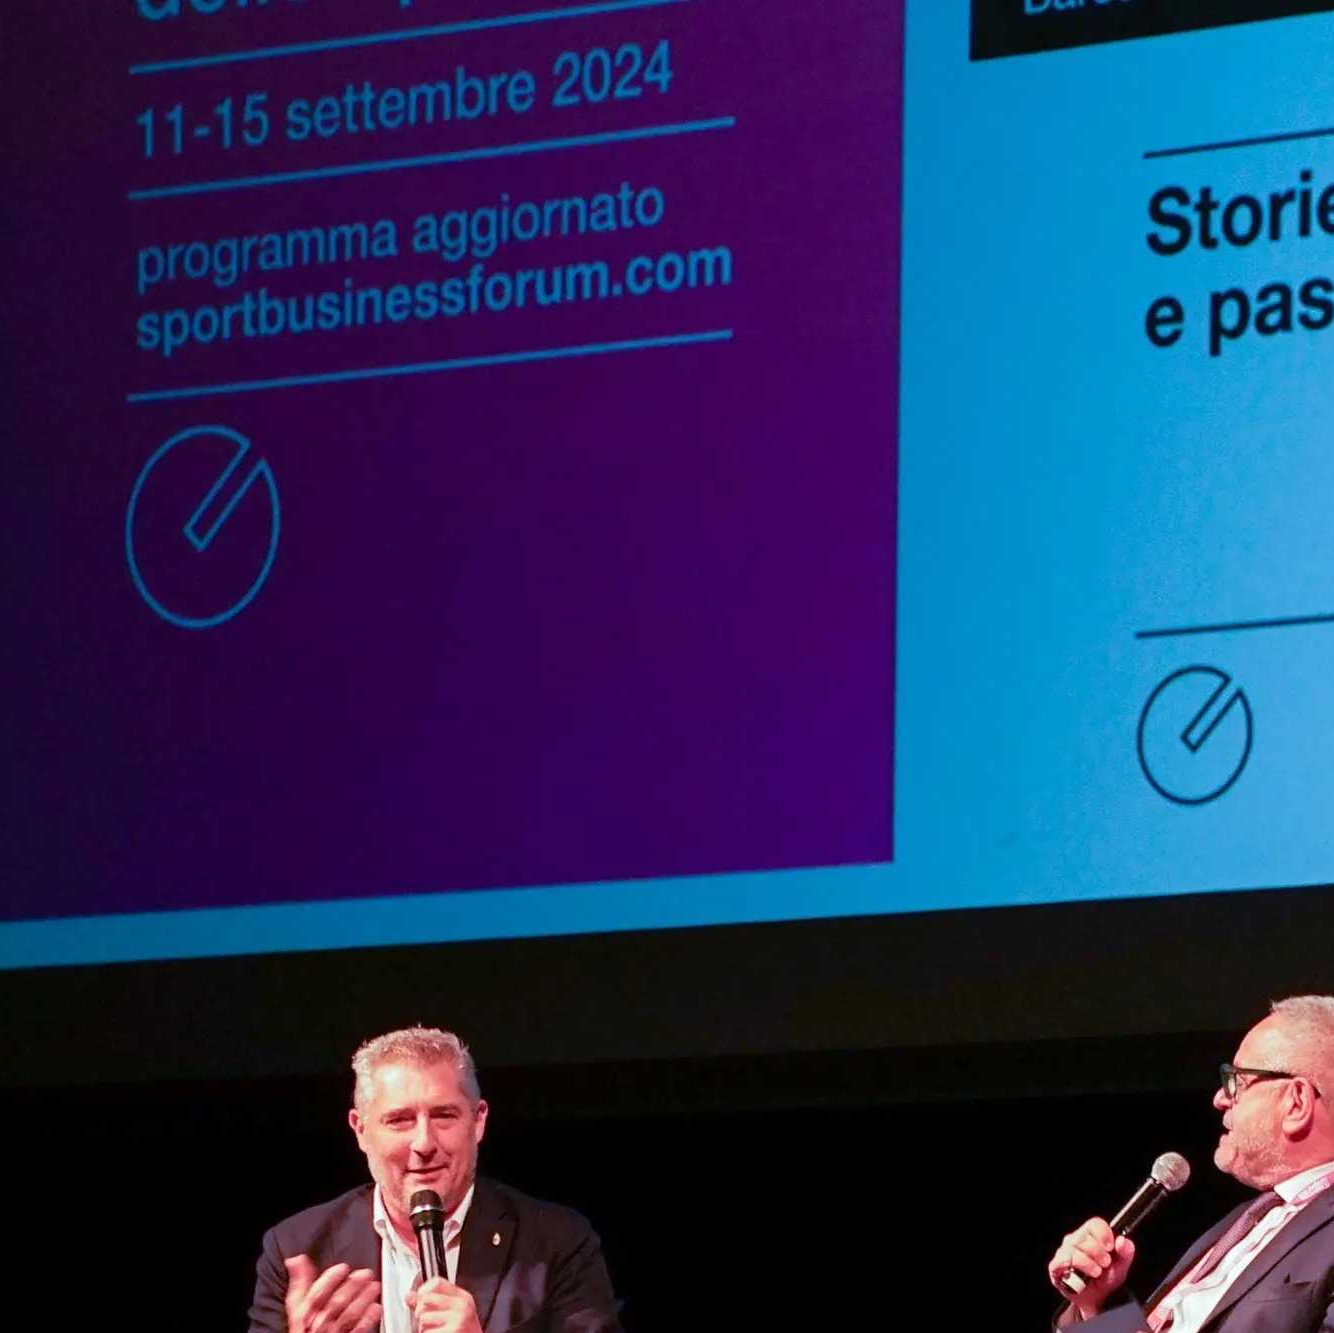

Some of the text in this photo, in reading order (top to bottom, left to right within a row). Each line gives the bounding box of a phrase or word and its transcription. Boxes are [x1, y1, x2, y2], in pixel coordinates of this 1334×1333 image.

[135, 40, 674, 159] 11-15 settembre 2024
[137, 181, 665, 294] programma aggiornato
[136, 246, 733, 356] sportbusinessforum.com
[1144, 295, 1185, 348] e
